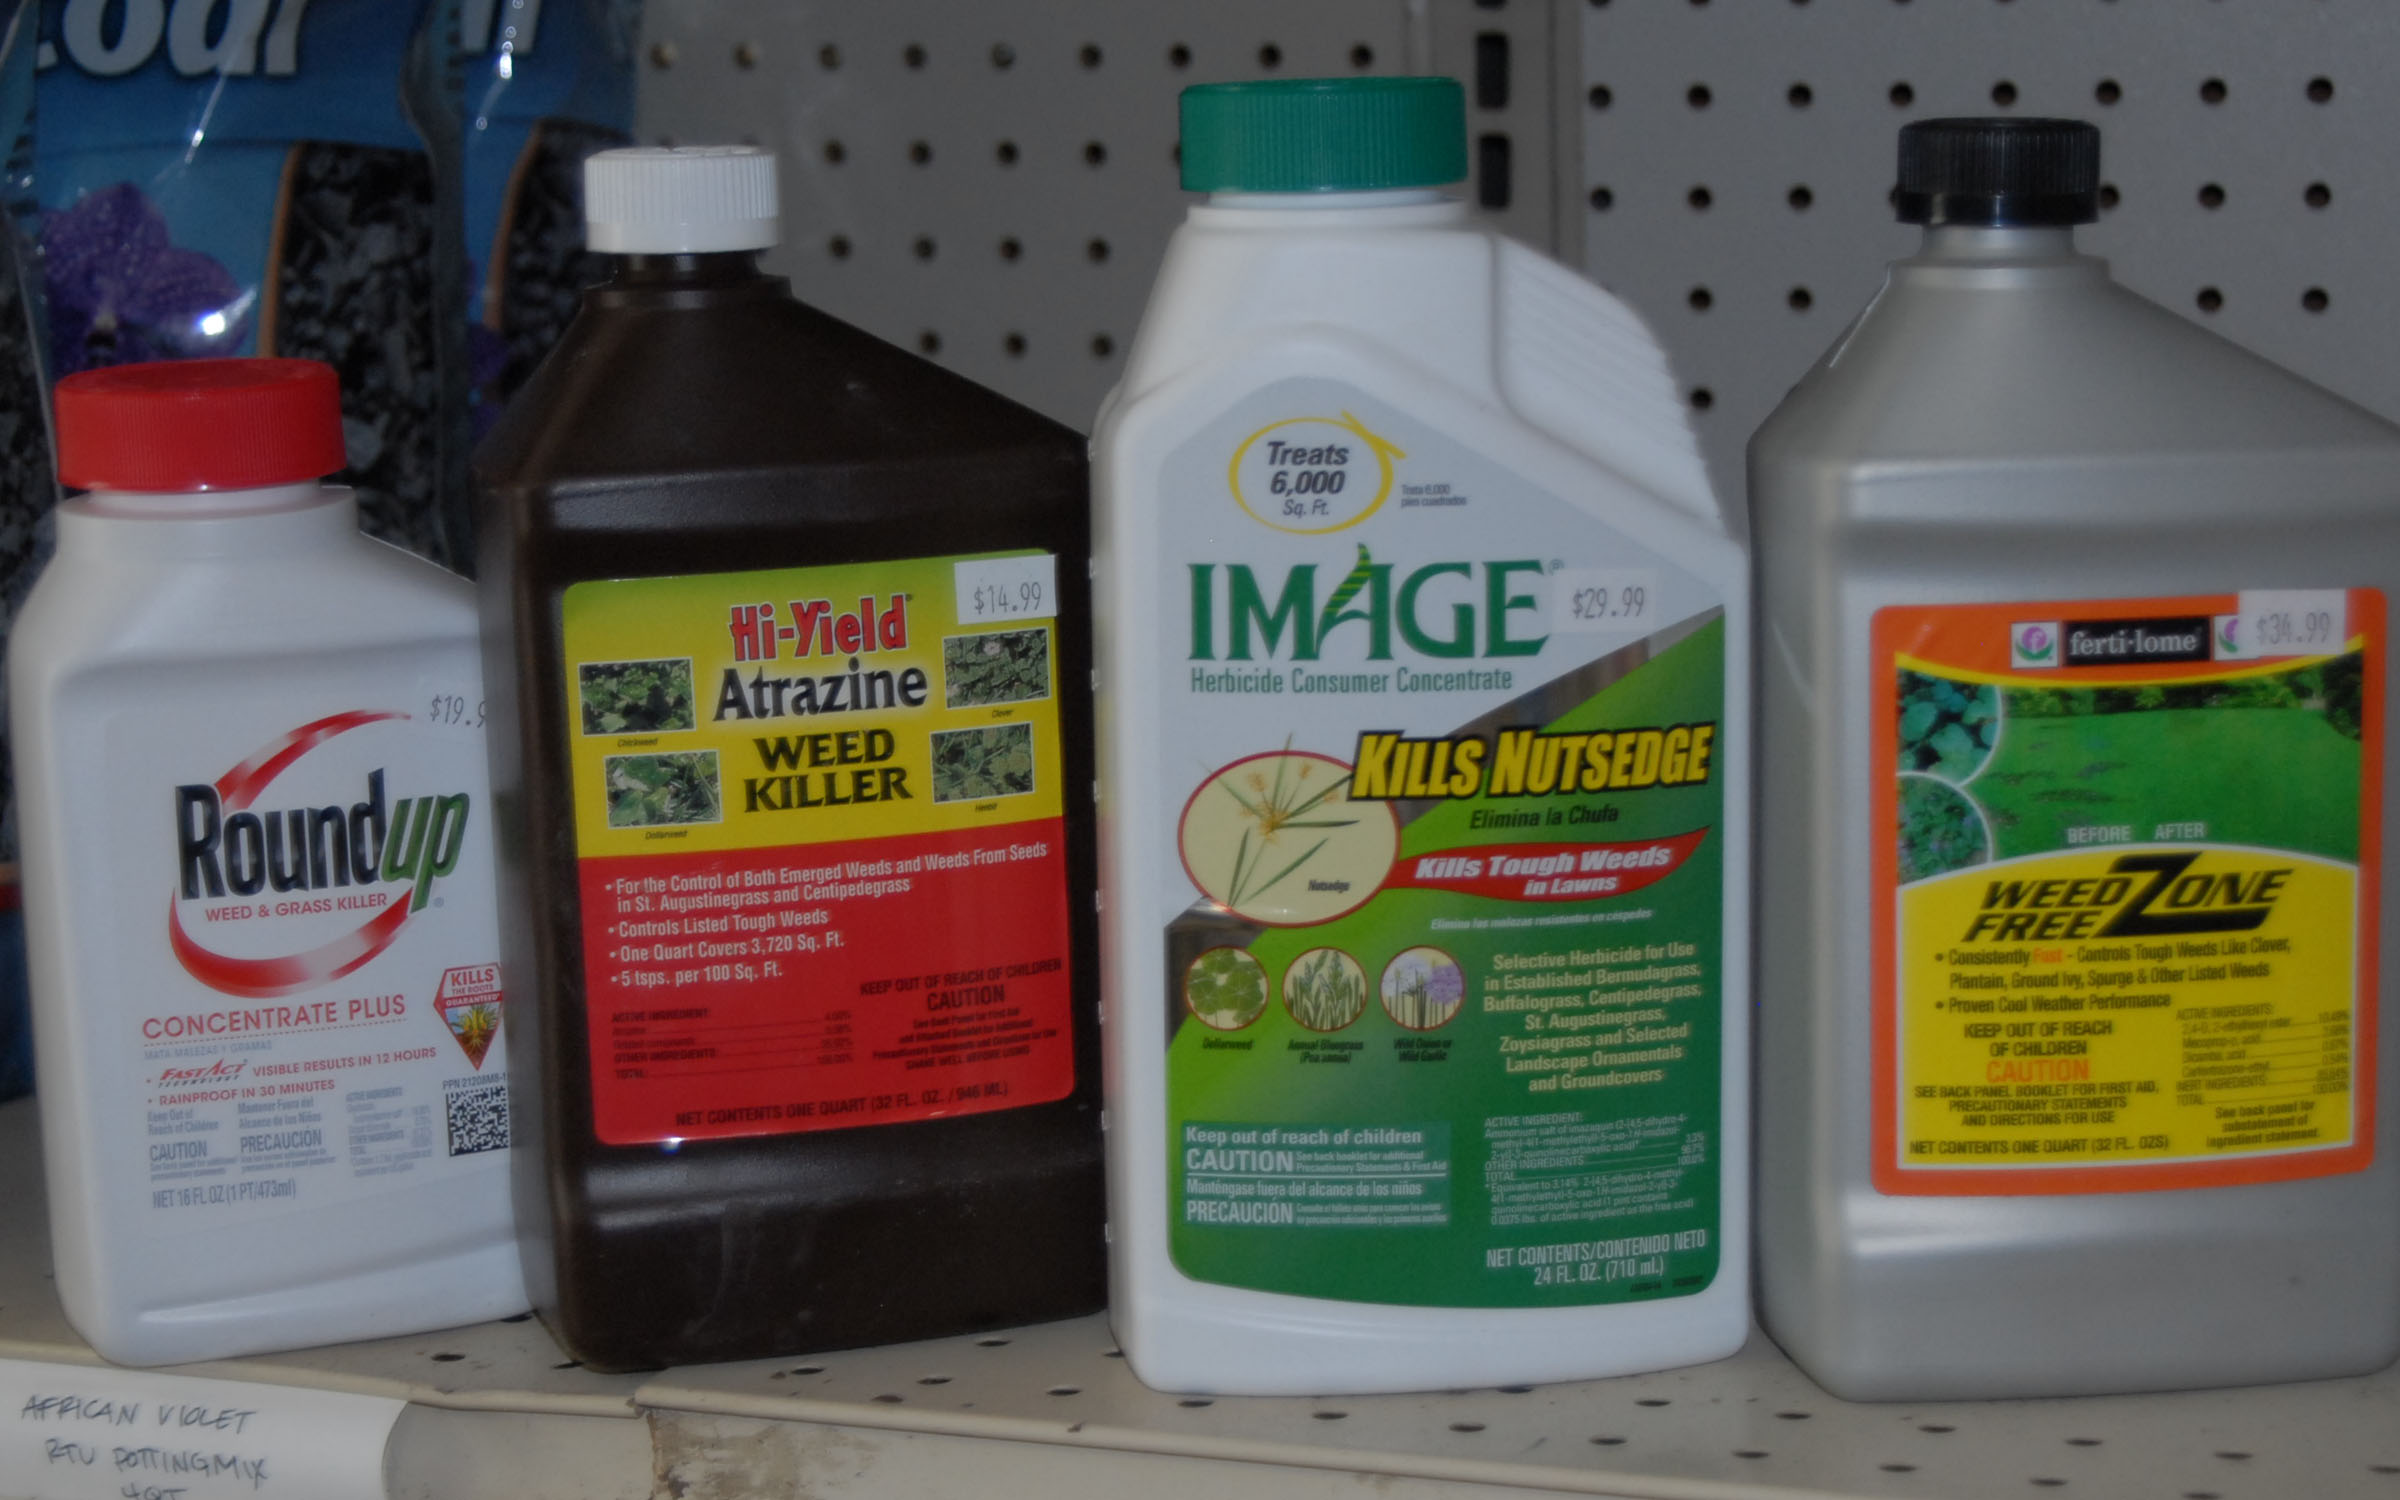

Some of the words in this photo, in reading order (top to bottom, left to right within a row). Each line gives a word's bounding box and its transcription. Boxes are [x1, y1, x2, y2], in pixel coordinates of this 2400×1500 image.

[1266, 440, 1350, 467] Treats
[1269, 470, 1346, 497] 6,000
[1282, 498, 1307, 518] Sq.
[1311, 498, 1330, 517] Ft.
[973, 580, 1042, 616] $14.99
[1187, 543, 1550, 662] IMAGE
[1572, 585, 1645, 619] $29.99
[728, 593, 910, 663] Hi-Yield
[2256, 611, 2331, 646] $34.99
[712, 656, 928, 722] Atrazine
[1190, 667, 1284, 693] Herbicide
[1291, 667, 1389, 693] Consumer
[1396, 667, 1513, 693] Concentrate
[752, 728, 896, 772] WEED
[1348, 730, 1488, 801] KILLS
[1487, 721, 1717, 797] NUTSEDGE
[743, 767, 914, 813] KILLER
[1470, 806, 1542, 830] Elimina
[1546, 806, 1562, 826] la
[1568, 804, 1619, 825] Chufa
[174, 766, 471, 914] Roundup
[2066, 825, 2132, 844] BEFORE
[2154, 821, 2206, 840] AFTER
[616, 877, 641, 895] For
[643, 876, 667, 893] the
[670, 873, 723, 893] Control
[726, 871, 741, 888] of
[744, 869, 776, 887] Both
[779, 863, 842, 886] Emerged
[846, 858, 893, 879] Weeds
[896, 855, 921, 874] and
[925, 851, 970, 870] Weeds
[973, 847, 1006, 866] From
[1009, 841, 1048, 860] Seeds
[1414, 856, 1482, 881] Kills
[1489, 851, 1576, 878] Tough
[1580, 845, 1672, 872] Weeds
[617, 896, 631, 913] in
[635, 894, 656, 913] St.
[660, 889, 770, 914] Augustinegrass
[773, 885, 800, 904] and
[802, 877, 912, 902] Centipedegrass
[1308, 879, 1351, 893] Nutsedge
[1523, 878, 1547, 896] in
[1550, 875, 1619, 894] Lawns
[1980, 874, 2134, 911] WEED
[2094, 850, 2295, 938] ZONE
[205, 905, 253, 923] WEED
[257, 904, 268, 918] &
[274, 898, 333, 917] GRASS
[336, 893, 389, 912] KILLER
[618, 916, 680, 938] Controls
[684, 914, 730, 935] Listed
[732, 912, 777, 932] Tough
[780, 907, 830, 927] Weeds
[1960, 909, 2105, 943] FREE
[620, 944, 650, 963] One
[653, 941, 695, 962] Quart
[697, 938, 748, 958] Covers
[751, 935, 794, 956] 3,720
[796, 932, 822, 954] Sq.
[825, 929, 846, 948] Ft.
[1493, 952, 1566, 971] Selective
[1570, 948, 1643, 967] Herbicide
[1645, 944, 1665, 961] for
[1668, 941, 1695, 958] Use
[1949, 947, 2030, 967] Consistently
[2032, 947, 2063, 963] Fast
[2077, 944, 2132, 963] Controls
[2135, 943, 2173, 962] Tough
[2176, 941, 2218, 958] Weeds
[2221, 939, 2247, 956] Like
[2250, 936, 2292, 954] Clover,
[450, 968, 495, 987] KILLS
[620, 969, 631, 988] 5
[634, 969, 671, 988] tsps.
[675, 968, 700, 987] per
[703, 963, 731, 982] 100
[734, 961, 760, 982] Sq.
[763, 959, 785, 978] Ft.
[860, 980, 893, 997] KEEP
[895, 976, 920, 993] OUT
[924, 973, 941, 989] OF
[944, 968, 985, 988] REACH
[986, 965, 1003, 982] OF
[1005, 957, 1062, 980] CHILDREN
[1949, 973, 2008, 991] Plantain,
[2011, 971, 2059, 988] Ground
[2087, 969, 2134, 989] Spurge
[2137, 968, 2147, 984] &
[2149, 967, 2185, 984] Other
[2188, 964, 2226, 981] Listed
[2230, 961, 2270, 979] Weeds
[926, 985, 1006, 1012] CAUTION
[1949, 996, 1995, 1014] Proven
[1999, 995, 2028, 1013] Cool
[2031, 994, 2087, 1012] Weather
[2089, 992, 2171, 1011] Performance
[142, 1002, 338, 1040] CONCENTRATE
[348, 994, 406, 1021] PLUS
[1964, 1023, 2003, 1039] KEEP
[2005, 1022, 2036, 1038] OUT
[2039, 1021, 2059, 1037] OF
[2062, 1020, 2113, 1036] REACH
[1498, 1034, 1592, 1055] Zoysiagrass
[1595, 1028, 1623, 1047] and
[1626, 1022, 1689, 1044] Selected
[1989, 1042, 2010, 1058] OF
[2012, 1040, 2088, 1057] CHILDREN
[253, 1062, 300, 1077] VISIBLE
[303, 1056, 355, 1073] RESULTS
[358, 1055, 372, 1067] IN
[376, 1053, 391, 1065] 12
[393, 1047, 437, 1062] HOURS
[1506, 1052, 1589, 1074] Landscape
[1592, 1044, 1684, 1066] Ornamentals
[1985, 1058, 2091, 1084] CAUTION
[159, 1088, 238, 1106] RAINPROOF
[241, 1087, 256, 1099] IN
[260, 1084, 276, 1097] 30
[279, 1080, 336, 1096] MINUTES
[1528, 1073, 1557, 1092] and
[1561, 1068, 1665, 1090] Groundcovers
[240, 1126, 323, 1152] PRECAUCIÓN
[1185, 1125, 1227, 1147] Keep
[1231, 1128, 1258, 1145] out
[1261, 1128, 1279, 1144] of
[1282, 1128, 1329, 1146] reach
[1333, 1128, 1350, 1146] of
[1354, 1127, 1423, 1145] children
[150, 1141, 208, 1162] CAUTION
[1185, 1147, 1294, 1173] CAUTION
[1185, 1196, 1294, 1225] PRECAUCIÓN
[1486, 1249, 1513, 1268] NET
[1517, 1234, 1671, 1266] CONTENTS/CONTENIDO
[1674, 1229, 1706, 1250] NETO
[1533, 1267, 1552, 1286] 24
[1556, 1266, 1577, 1284] FL.
[1579, 1263, 1602, 1282] OZ.
[1605, 1259, 1636, 1283] (710
[21, 1394, 140, 1427] AFRICAN
[158, 1405, 258, 1435] VIOLET
[44, 1437, 96, 1466] RTU
